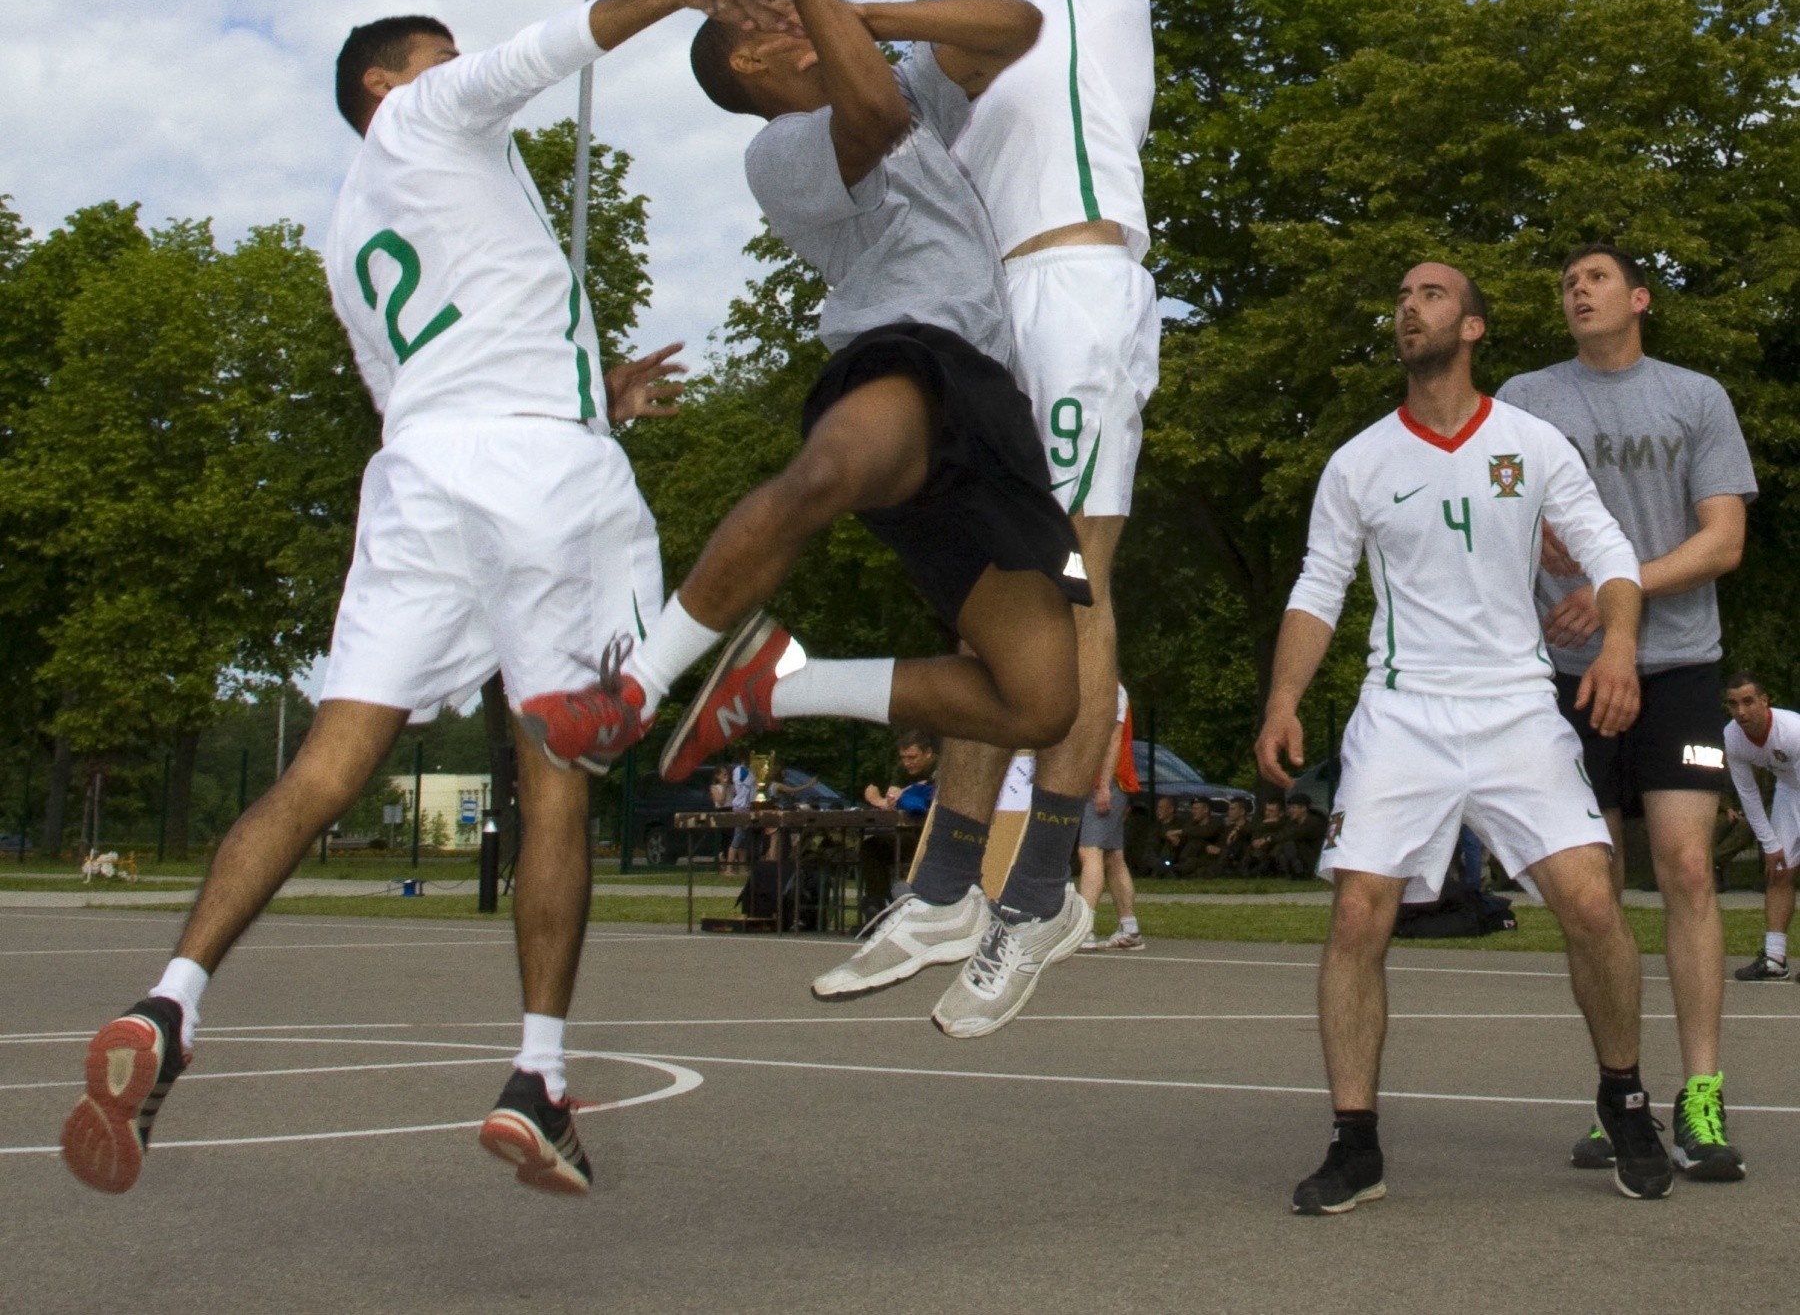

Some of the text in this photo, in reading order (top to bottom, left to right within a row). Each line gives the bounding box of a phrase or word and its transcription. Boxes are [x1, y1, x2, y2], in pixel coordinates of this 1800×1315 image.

[355, 228, 463, 366] 2
[1050, 396, 1083, 468] 9
[1442, 496, 1473, 553] 4
[716, 694, 750, 739] N
